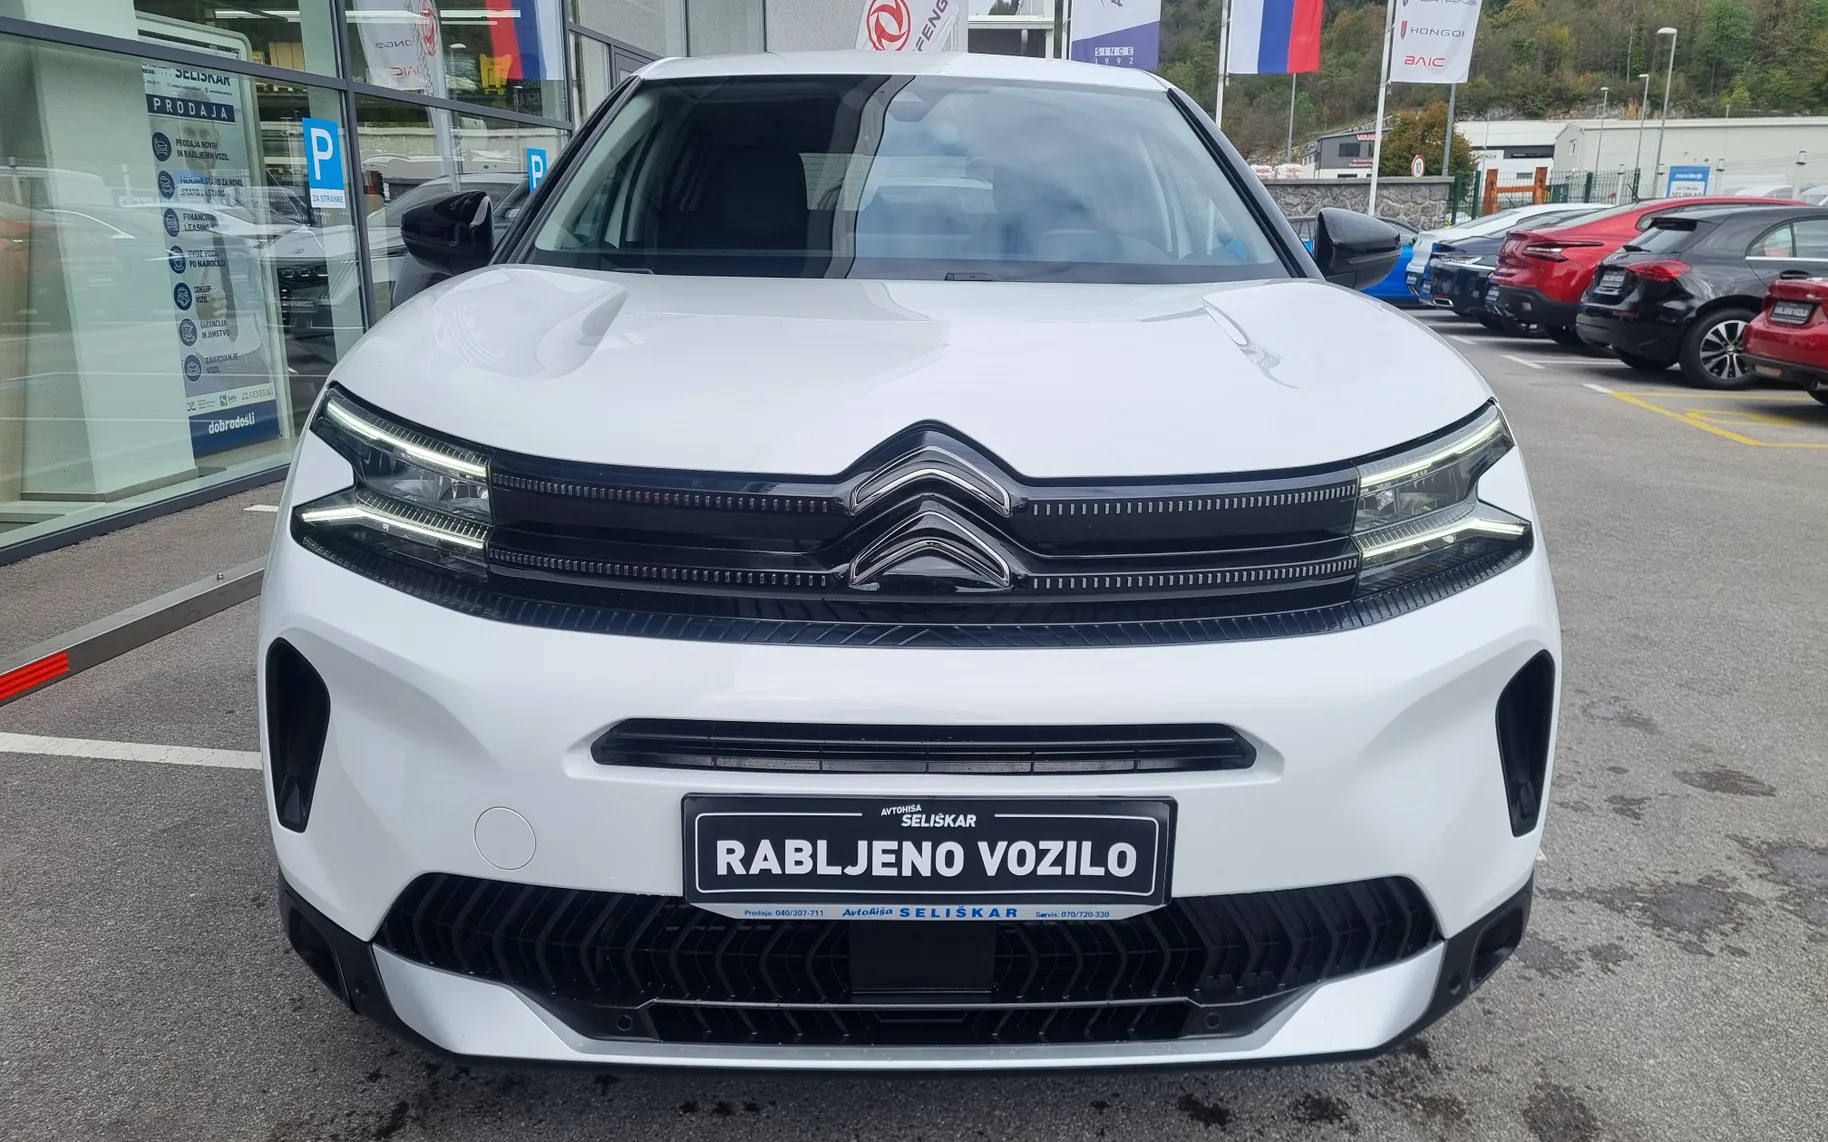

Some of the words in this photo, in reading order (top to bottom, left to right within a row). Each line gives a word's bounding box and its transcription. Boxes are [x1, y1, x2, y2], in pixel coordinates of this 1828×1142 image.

[1410, 27, 1465, 37] HONGQI
[1095, 47, 1133, 56] SINCE
[1095, 57, 1134, 65] 1992
[1404, 55, 1445, 67] BAIC
[153, 97, 228, 119] PRODAJA
[176, 139, 200, 148] PRODAJA
[215, 152, 230, 161] VOZIL
[310, 128, 333, 180] P
[531, 155, 543, 189] P
[312, 194, 320, 202] ZA
[320, 195, 344, 203] STRANKE
[189, 260, 197, 268] PO
[200, 319, 228, 329] GARANCIJA
[207, 329, 231, 338] JAMSTVO
[206, 366, 221, 374] VOZIL
[208, 412, 255, 434] dobrodošli
[880, 804, 922, 816] AVTOHIŠA
[901, 812, 977, 827] SELIŠKAR
[716, 839, 965, 877] RABLJENO
[977, 840, 1138, 878] VOZILO
[744, 909, 774, 917] Prodaja:
[775, 909, 824, 917] 040/307-711
[899, 905, 1017, 918] SELIŠKAR
